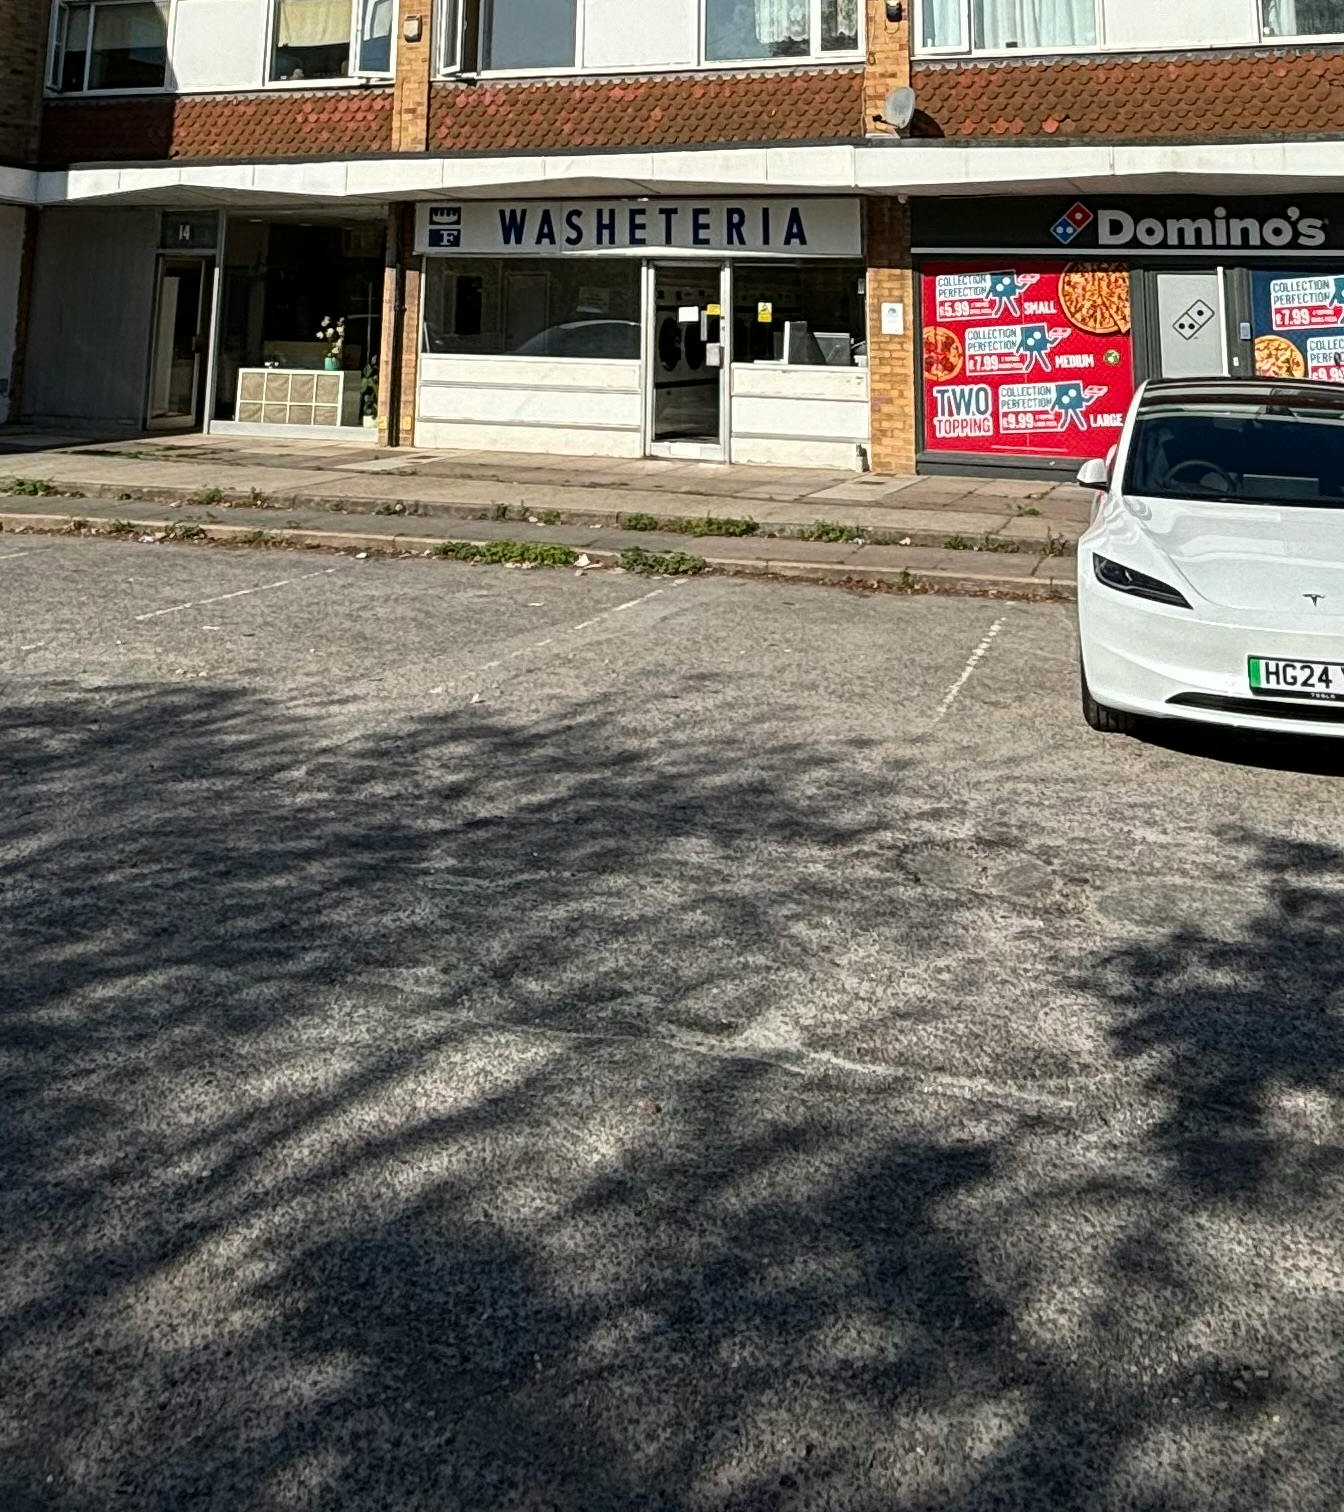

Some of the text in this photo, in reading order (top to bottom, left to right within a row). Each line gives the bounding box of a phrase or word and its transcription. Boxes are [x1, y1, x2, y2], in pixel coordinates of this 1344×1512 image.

[178, 224, 191, 241] 14
[498, 207, 808, 245] WASHETERIA
[1098, 206, 1326, 246] Domino's
[937, 275, 987, 287] COLLECTION
[1272, 279, 1330, 293] COLLECTION
[938, 287, 987, 299] PERFECTION
[1273, 292, 1331, 306] PERFECTION
[939, 301, 970, 317] £5.99
[1023, 300, 1057, 316] SMALL
[1275, 308, 1310, 325] £7.99
[968, 328, 1017, 340] COLLECTION
[968, 339, 1017, 351] PERFECTION
[969, 355, 999, 371] £7.99
[1055, 354, 1094, 368] MEDIUM
[1001, 385, 1052, 397] COLLECTION
[936, 386, 989, 418] TWO
[1001, 397, 1053, 409] PERFECTION
[936, 417, 992, 436] TOPPING
[1002, 413, 1034, 429] £9.99
[1090, 413, 1124, 427] LARGE
[1264, 661, 1333, 689] HG24
